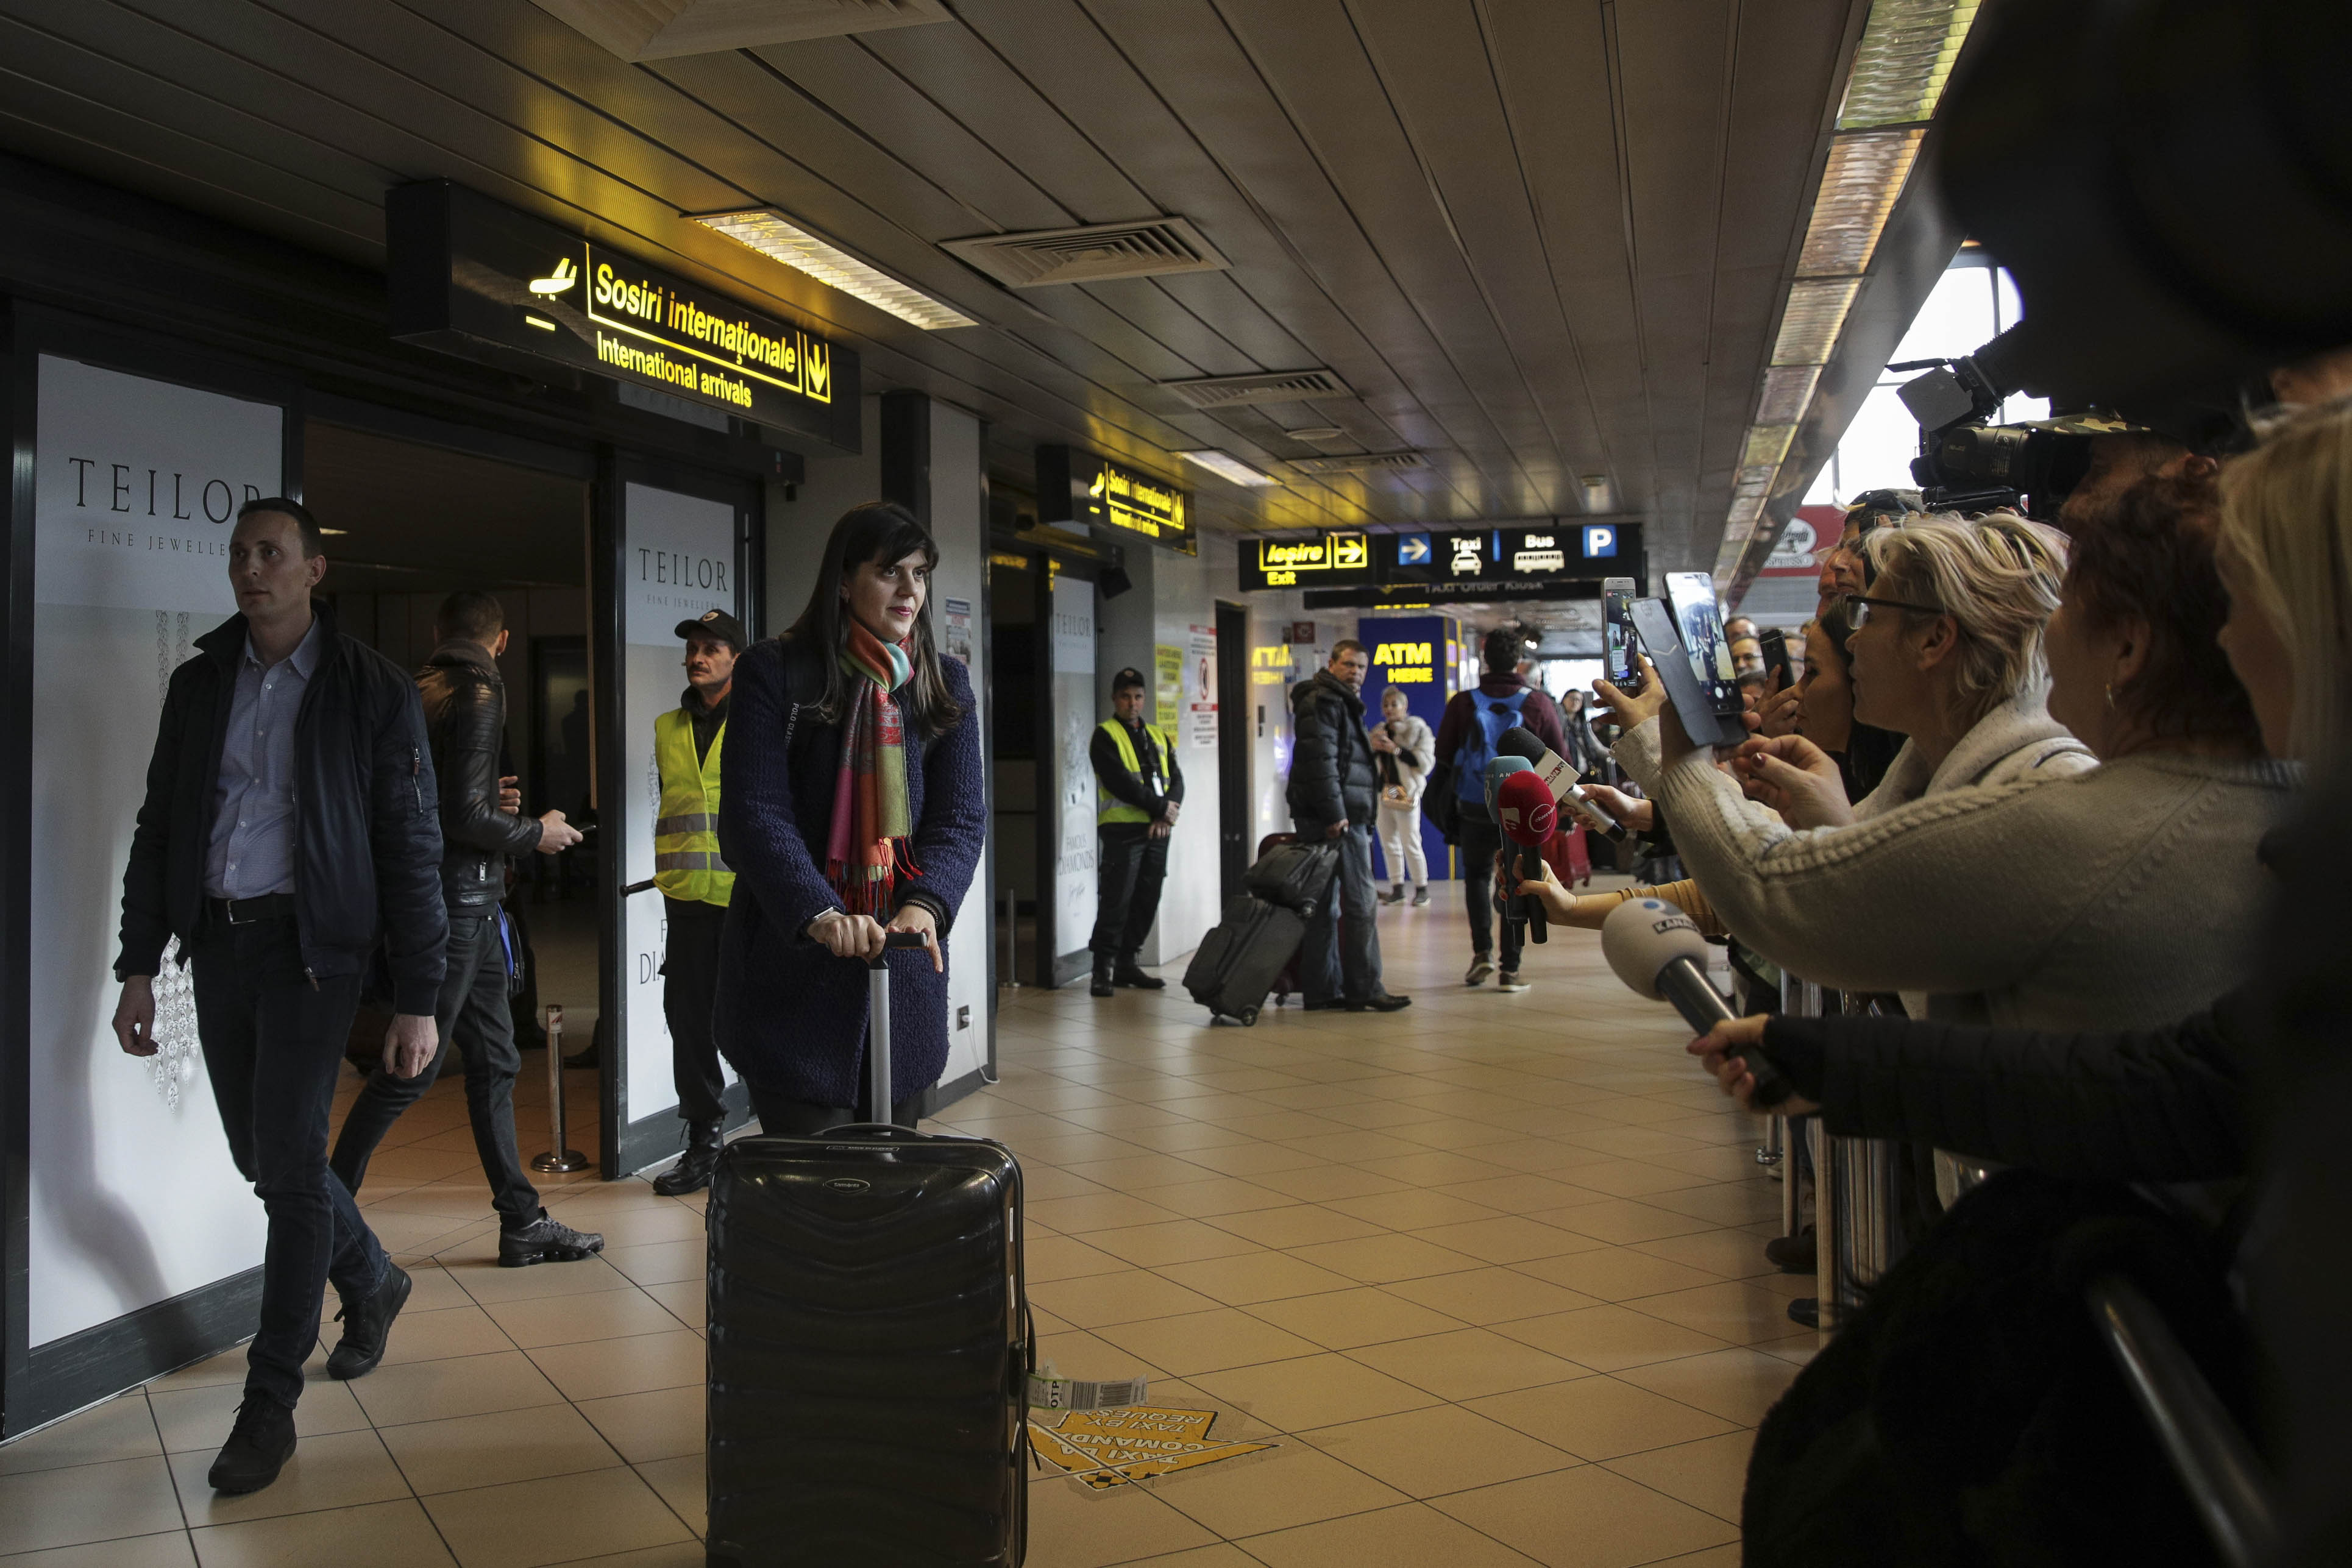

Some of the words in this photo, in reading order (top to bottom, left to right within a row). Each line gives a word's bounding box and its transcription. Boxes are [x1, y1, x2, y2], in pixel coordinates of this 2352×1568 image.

[595, 263, 663, 323] Sosiri
[597, 331, 697, 391] International
[701, 371, 751, 408] arrivals
[88, 529, 134, 547] FINE
[148, 536, 226, 556] JEWELLE
[1450, 537, 1482, 552] Taxi
[1525, 534, 1555, 549] Bus
[1589, 528, 1613, 556] P
[639, 548, 727, 592] TEILOR
[1267, 571, 1296, 586] Exit
[1373, 643, 1432, 665] ATM
[1387, 667, 1434, 684] HERE
[790, 703, 800, 722] POLO
[1051, 1380, 1059, 1408] OTP
[1083, 1419, 1127, 1428] BY
[1127, 1421, 1185, 1432] TAXI
[1107, 1449, 1179, 1464] TAXI
